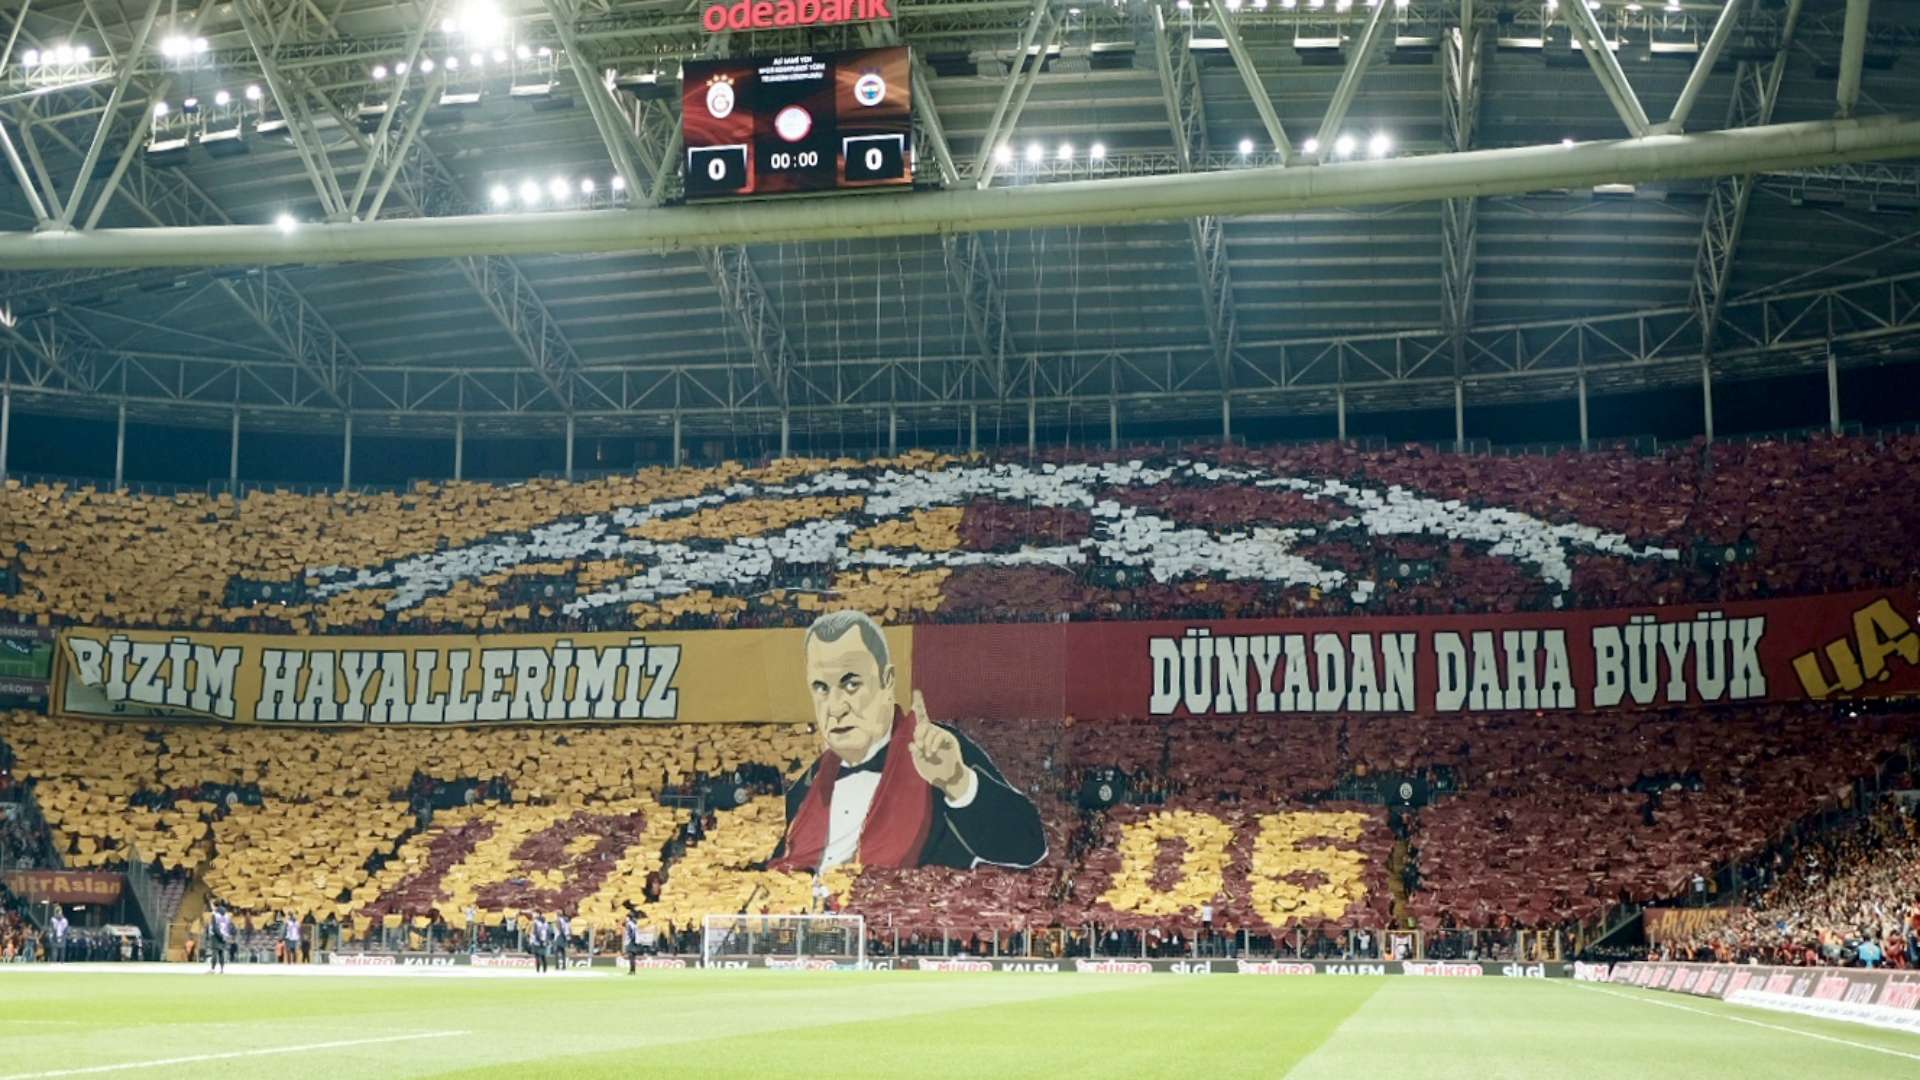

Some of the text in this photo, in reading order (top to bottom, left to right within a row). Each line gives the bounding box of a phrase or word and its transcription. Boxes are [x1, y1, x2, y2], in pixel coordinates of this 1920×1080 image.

[703, 0, 891, 31] odeabank
[708, 158, 726, 181] 0
[771, 152, 818, 169] 00:00
[865, 148, 883, 170] 0
[1149, 611, 1766, 714] DÜNYADAN DAHA BÜYÜK
[68, 635, 681, 723] BİZİM HAYALLERİMİZ
